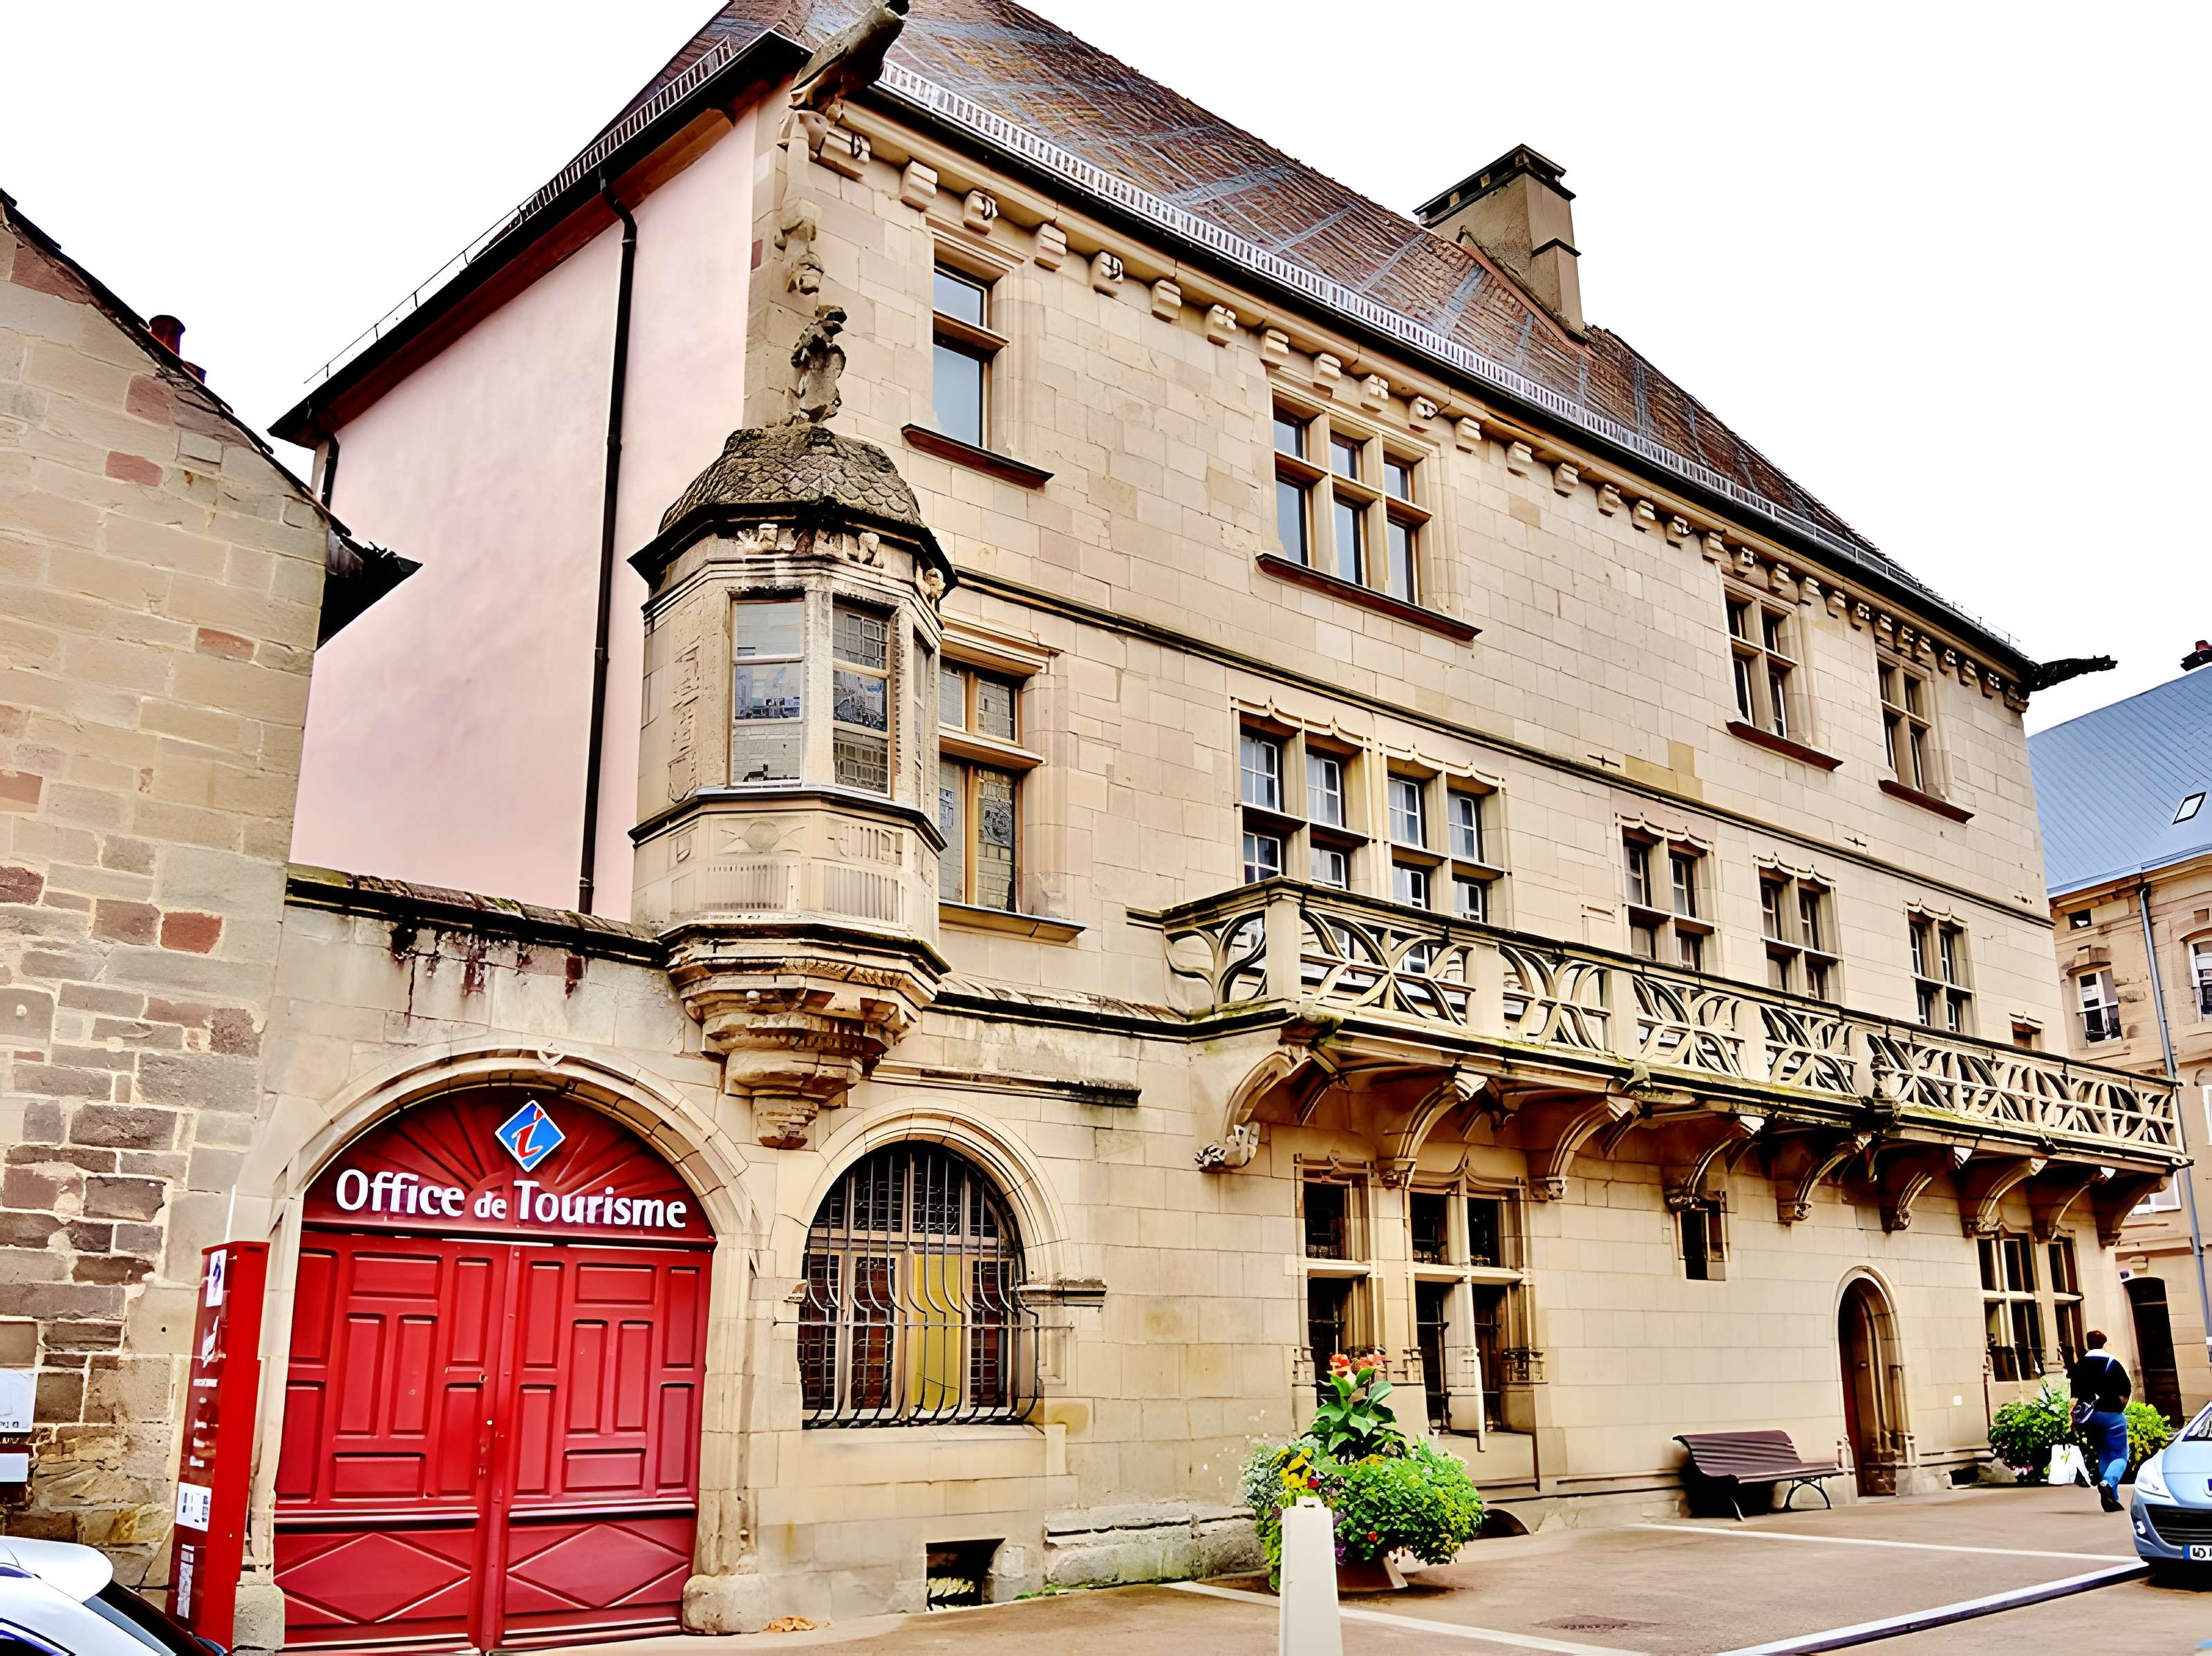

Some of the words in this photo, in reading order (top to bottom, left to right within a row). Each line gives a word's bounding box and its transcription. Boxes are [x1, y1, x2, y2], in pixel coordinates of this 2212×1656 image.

[335, 1168, 464, 1217] Office
[474, 1191, 507, 1220] de
[513, 1179, 687, 1229] Tourisme
